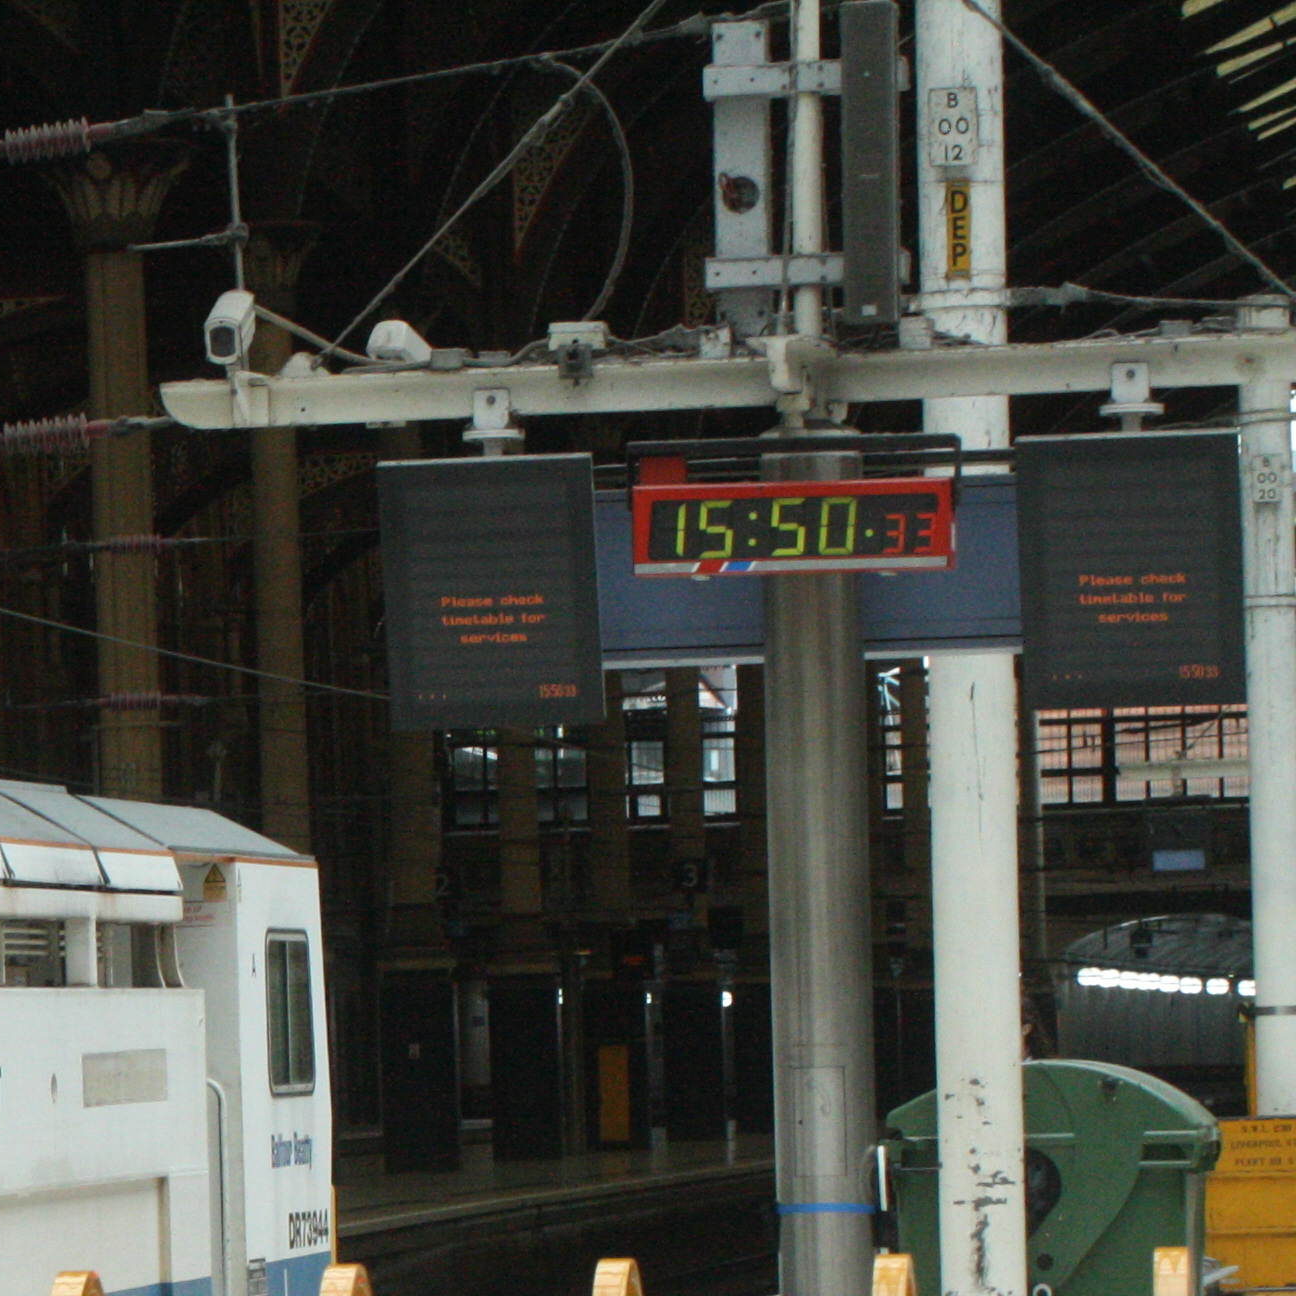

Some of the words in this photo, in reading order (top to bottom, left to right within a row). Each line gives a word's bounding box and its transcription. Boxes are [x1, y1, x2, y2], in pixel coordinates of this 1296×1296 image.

[947, 92, 959, 109] B
[944, 144, 963, 161] 12
[950, 190, 968, 267] DEP
[1079, 574, 1134, 586] Please
[1141, 572, 1186, 584] check
[441, 596, 494, 608] Please
[500, 594, 544, 606] check
[1079, 592, 1154, 605] timetable
[1162, 591, 1188, 602] for
[441, 612, 515, 626] timetable
[521, 612, 546, 624] for
[1098, 611, 1169, 623] services
[460, 632, 528, 644] services
[288, 1208, 329, 1250] DR73944
